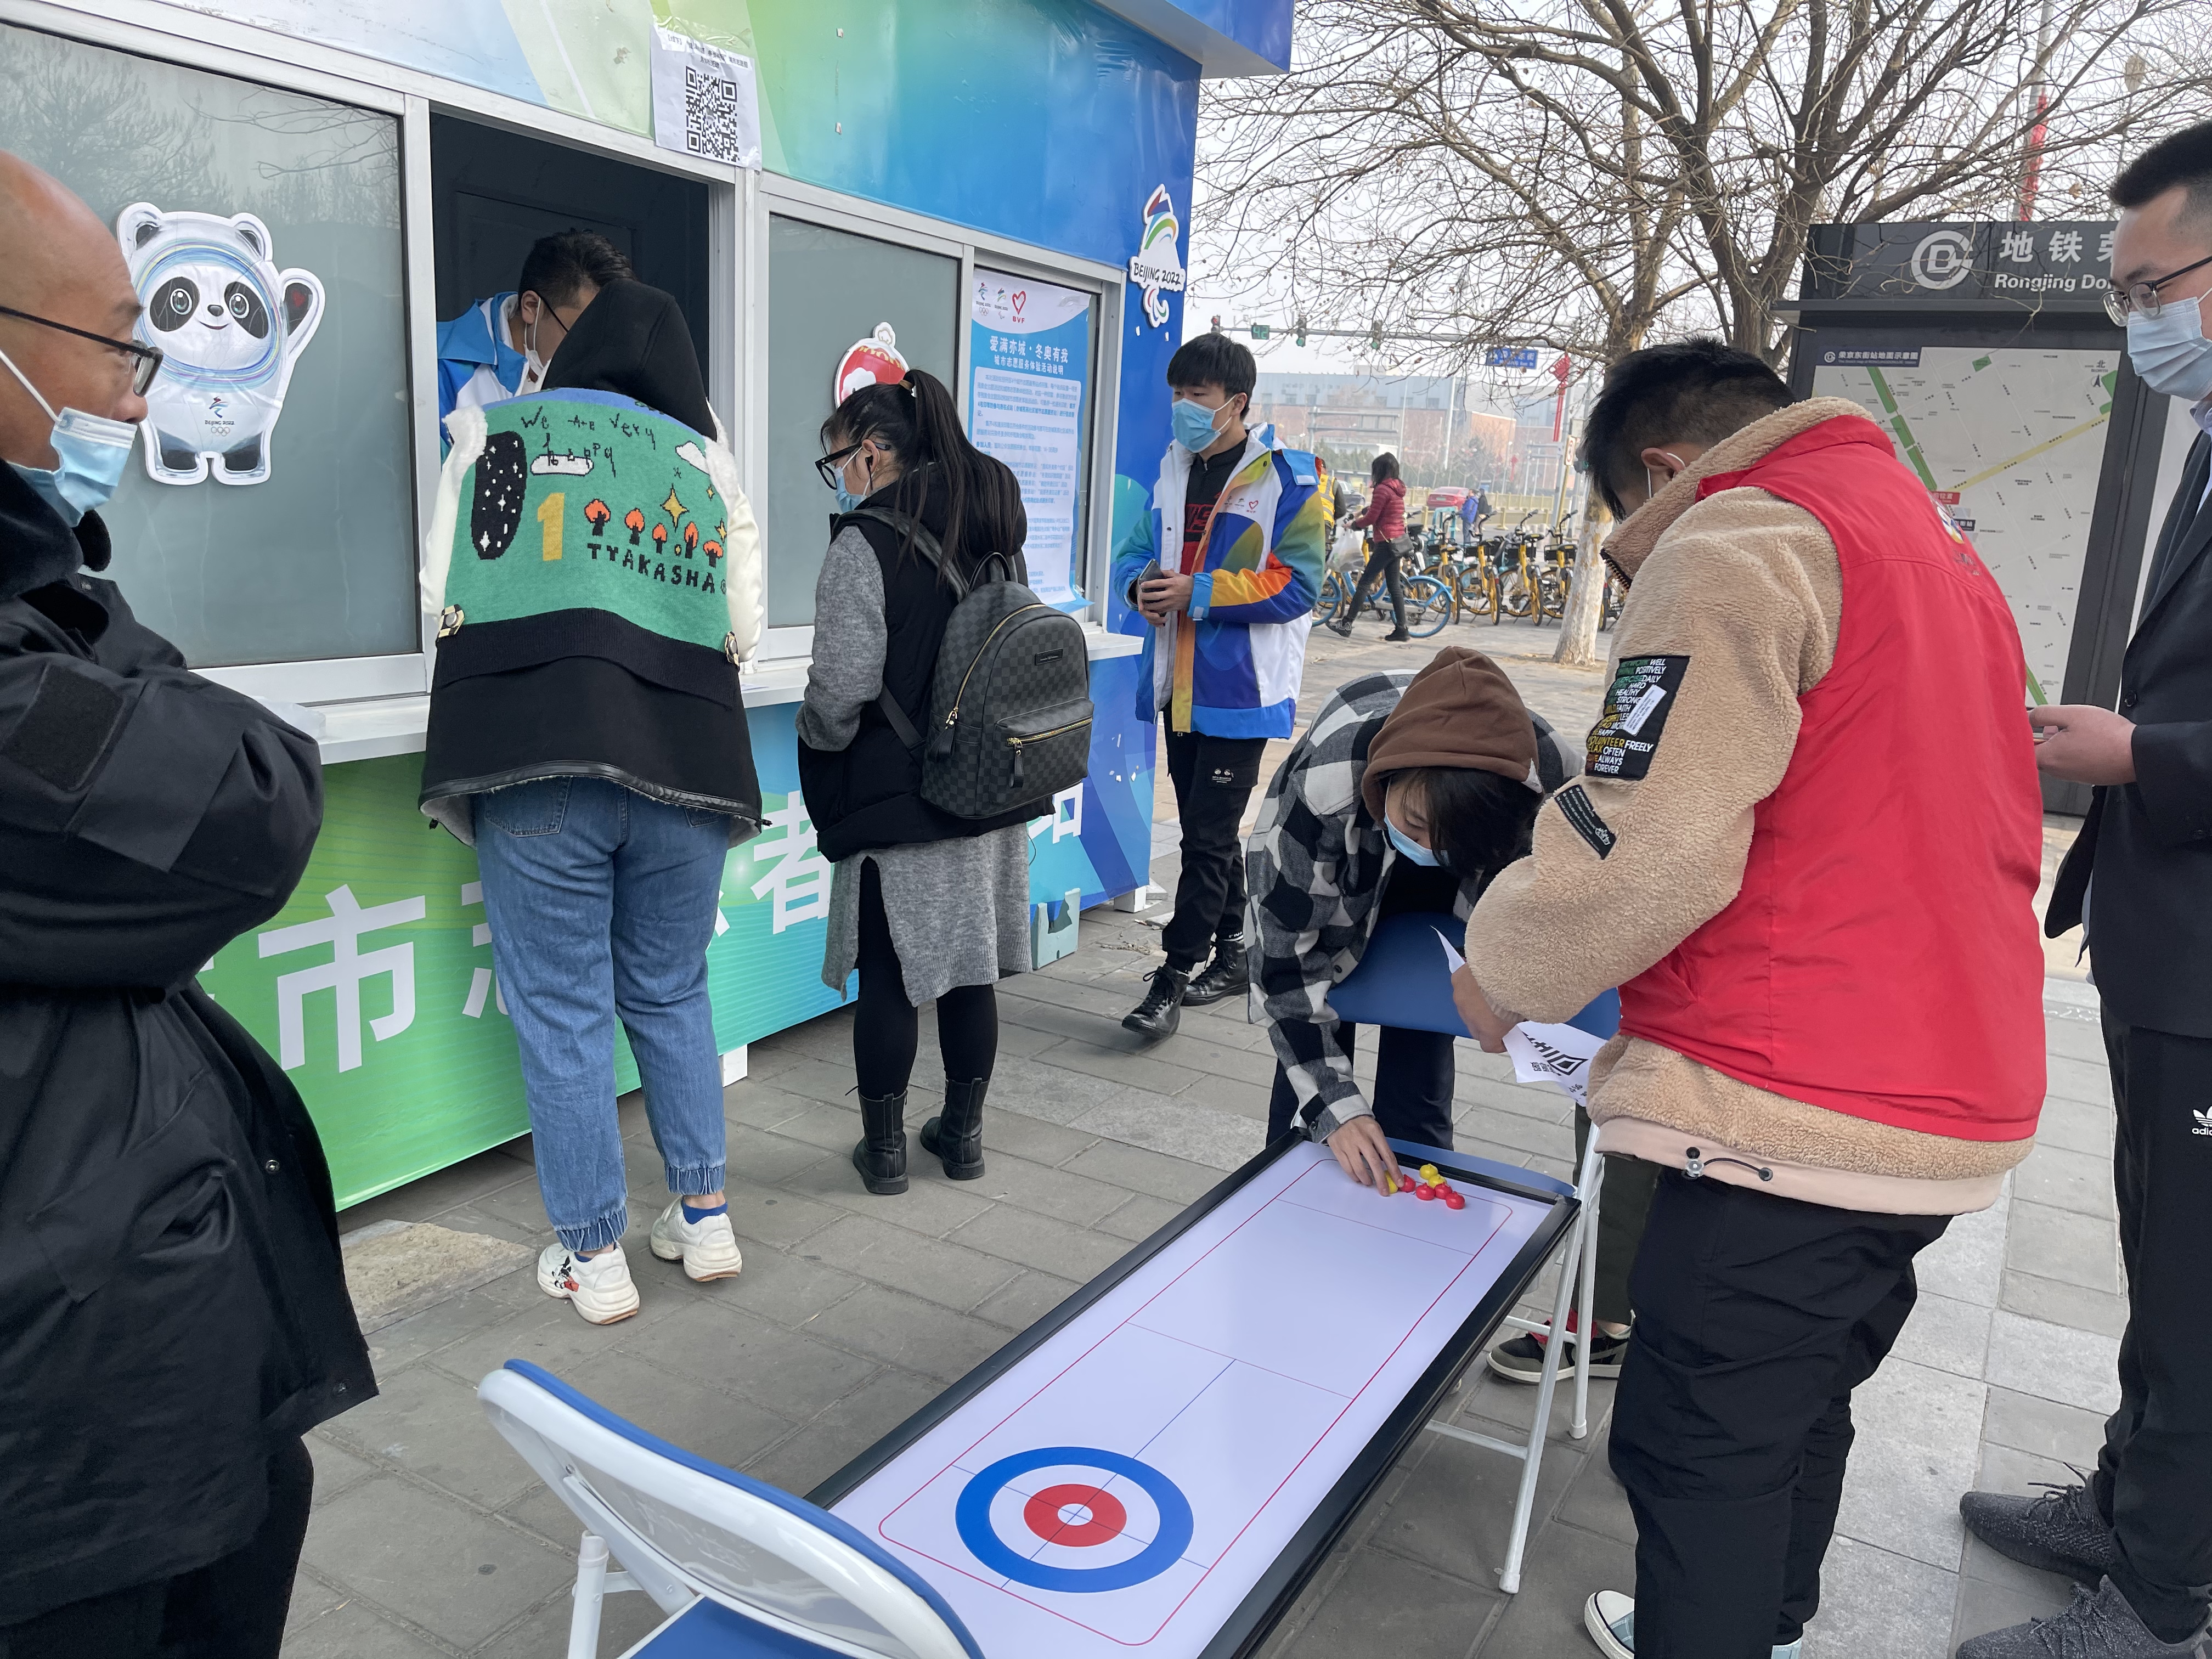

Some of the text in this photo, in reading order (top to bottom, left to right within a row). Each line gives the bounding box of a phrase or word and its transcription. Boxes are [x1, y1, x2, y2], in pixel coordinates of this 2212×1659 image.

[1133, 262, 1181, 285] BEIJING 2022
[1994, 273, 2076, 292] Rongjing
[1012, 315, 1025, 324] BVF
[1253, 326, 1268, 340] 42
[2096, 360, 2106, 368] 北
[1635, 666, 1667, 674] POSITIVELY
[1641, 675, 1662, 683] DAILY
[1603, 746, 1626, 757] OFTEN
[1624, 740, 1654, 752] FREELY
[1598, 755, 1623, 765] ALWAYS
[1594, 763, 1620, 774] FOREVER
